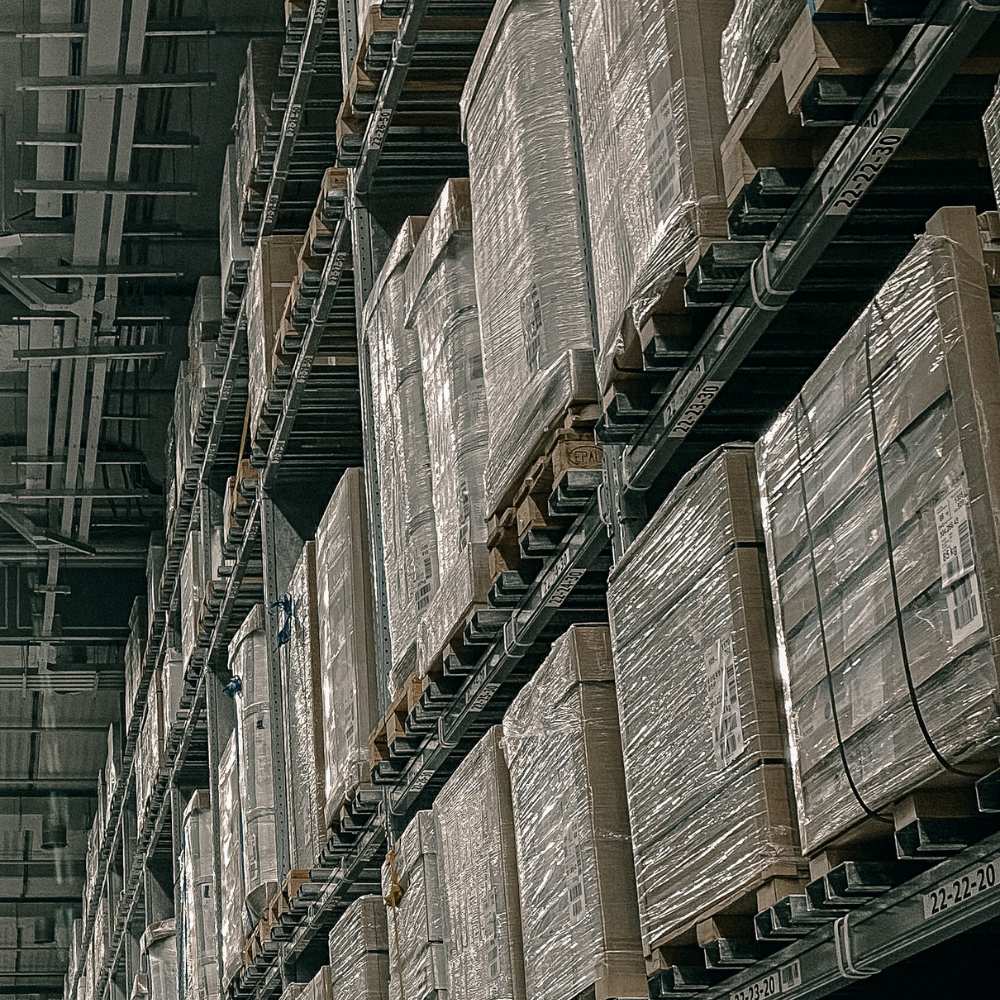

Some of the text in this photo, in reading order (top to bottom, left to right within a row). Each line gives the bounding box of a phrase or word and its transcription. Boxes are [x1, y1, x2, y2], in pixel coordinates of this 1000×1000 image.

[371, 112, 390, 146] 22-26-50
[834, 136, 902, 207] 22-22-30
[673, 385, 719, 433] 22-23-30
[575, 451, 602, 463] EPAL
[549, 571, 584, 603] 22-24-30
[930, 863, 995, 915] 22-22-20
